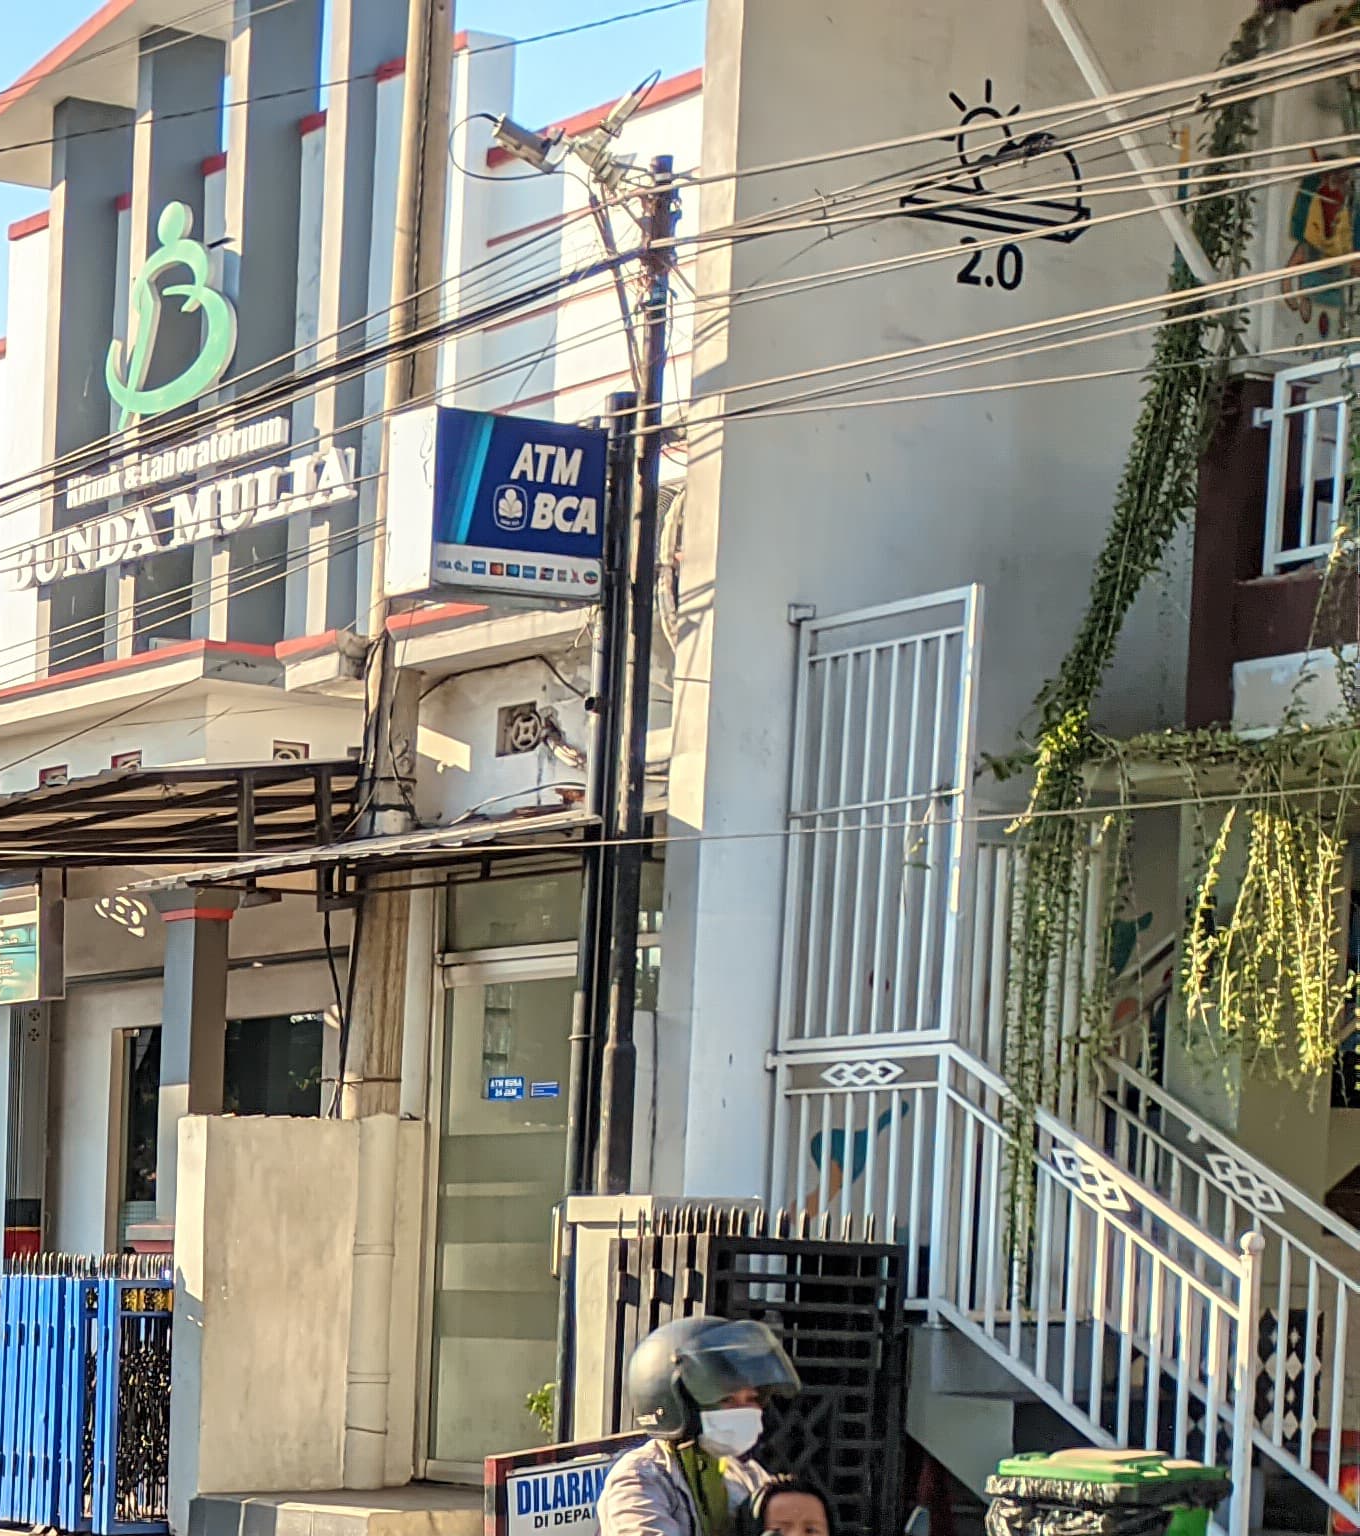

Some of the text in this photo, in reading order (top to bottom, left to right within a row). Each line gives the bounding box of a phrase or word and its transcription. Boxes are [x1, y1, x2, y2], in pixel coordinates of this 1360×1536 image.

[957, 236, 1023, 290] 2.0
[510, 442, 583, 486] ATM
[11, 446, 358, 592] BUNDA MULIA
[531, 492, 597, 535] BCA
[516, 1467, 609, 1515] DILARAN
[534, 1506, 597, 1528] DI DEPA
